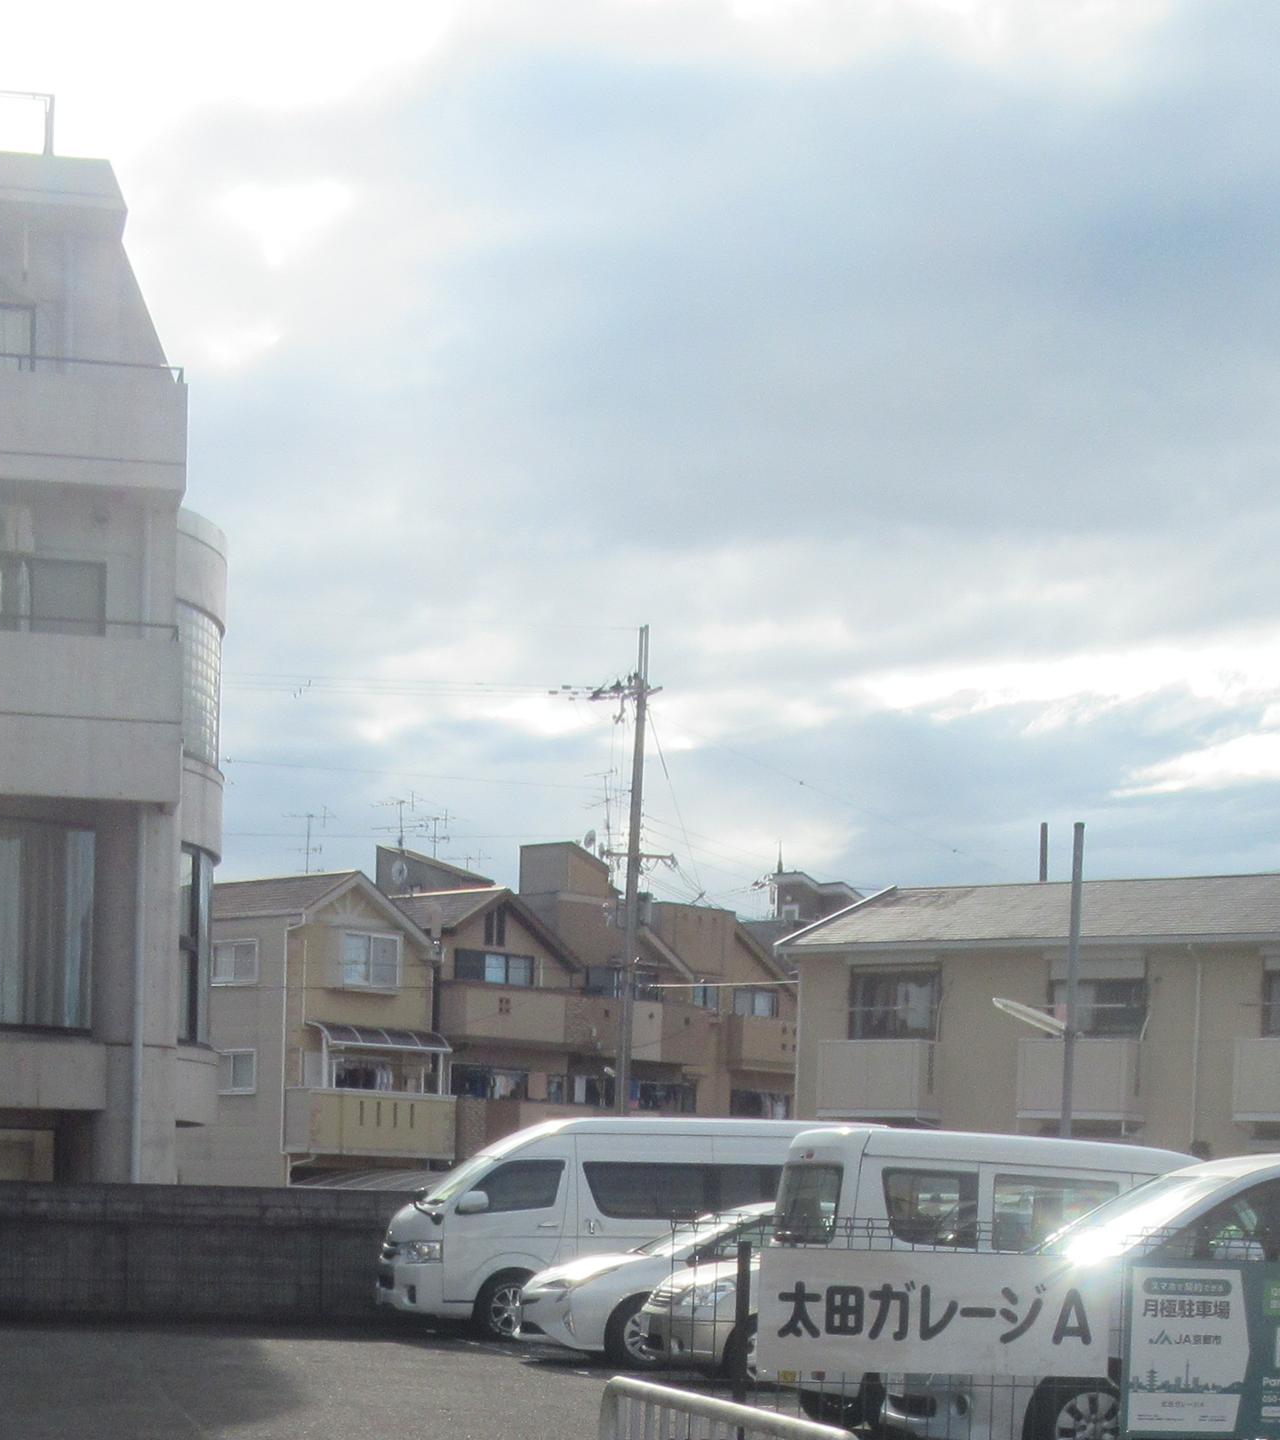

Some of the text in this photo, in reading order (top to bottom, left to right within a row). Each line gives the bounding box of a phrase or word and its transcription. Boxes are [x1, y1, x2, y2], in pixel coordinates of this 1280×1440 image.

[1143, 1299, 1231, 1319] 月極駐車場
